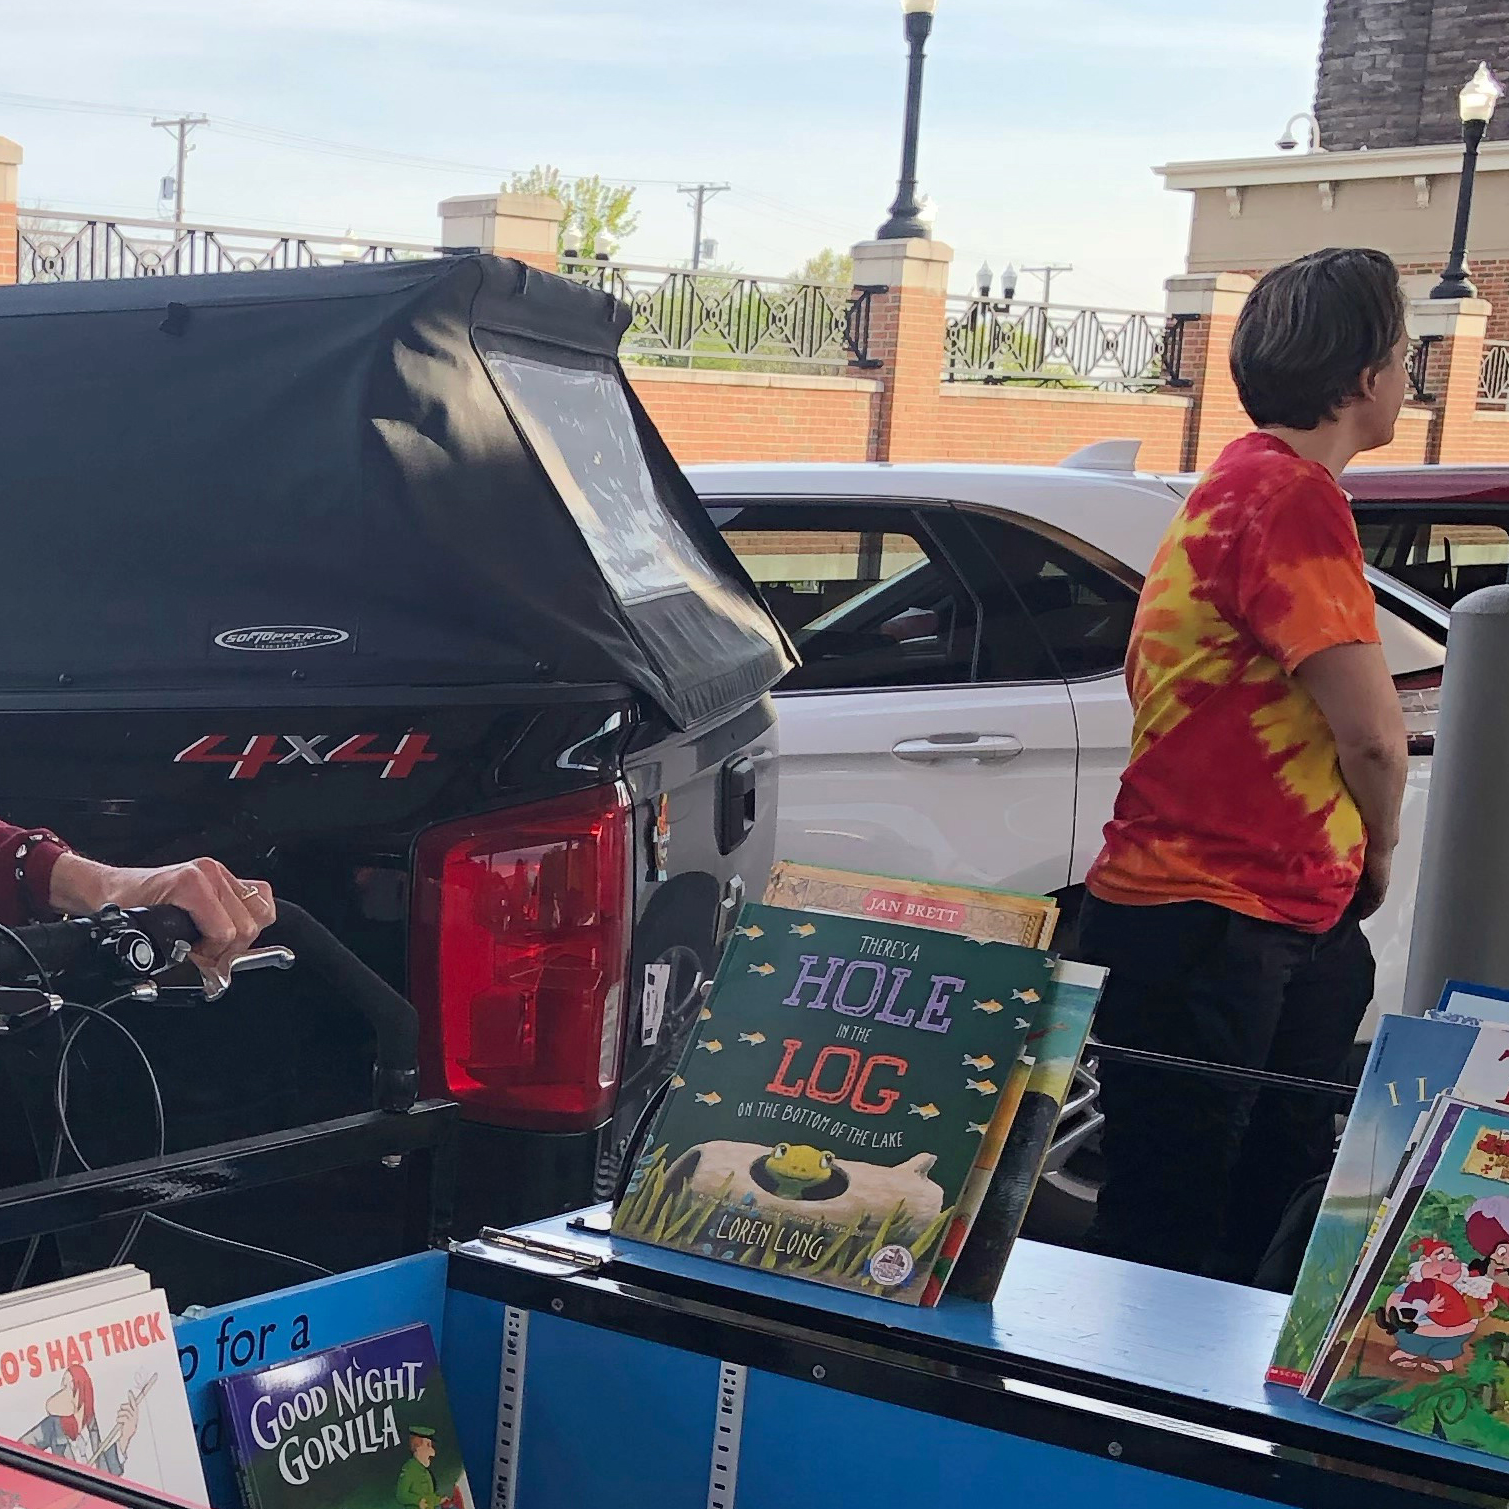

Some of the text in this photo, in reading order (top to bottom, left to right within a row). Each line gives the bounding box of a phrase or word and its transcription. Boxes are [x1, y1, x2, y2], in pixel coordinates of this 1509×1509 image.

[866, 897, 959, 923] JAN BRETT
[859, 935, 922, 962] THERE'S A
[782, 954, 966, 1034] HOLE
[836, 1023, 873, 1043] IN THE
[765, 1038, 909, 1115] LOG
[737, 1101, 904, 1148] ON THE BOTTOM OF THE LAKE
[716, 1214, 825, 1261] LOREN LONG
[46, 1330, 93, 1372] HAT
[97, 1311, 167, 1358] TRICK
[216, 1316, 277, 1372] for
[290, 1313, 311, 1352] a
[278, 1404, 402, 1486] GORILLA
